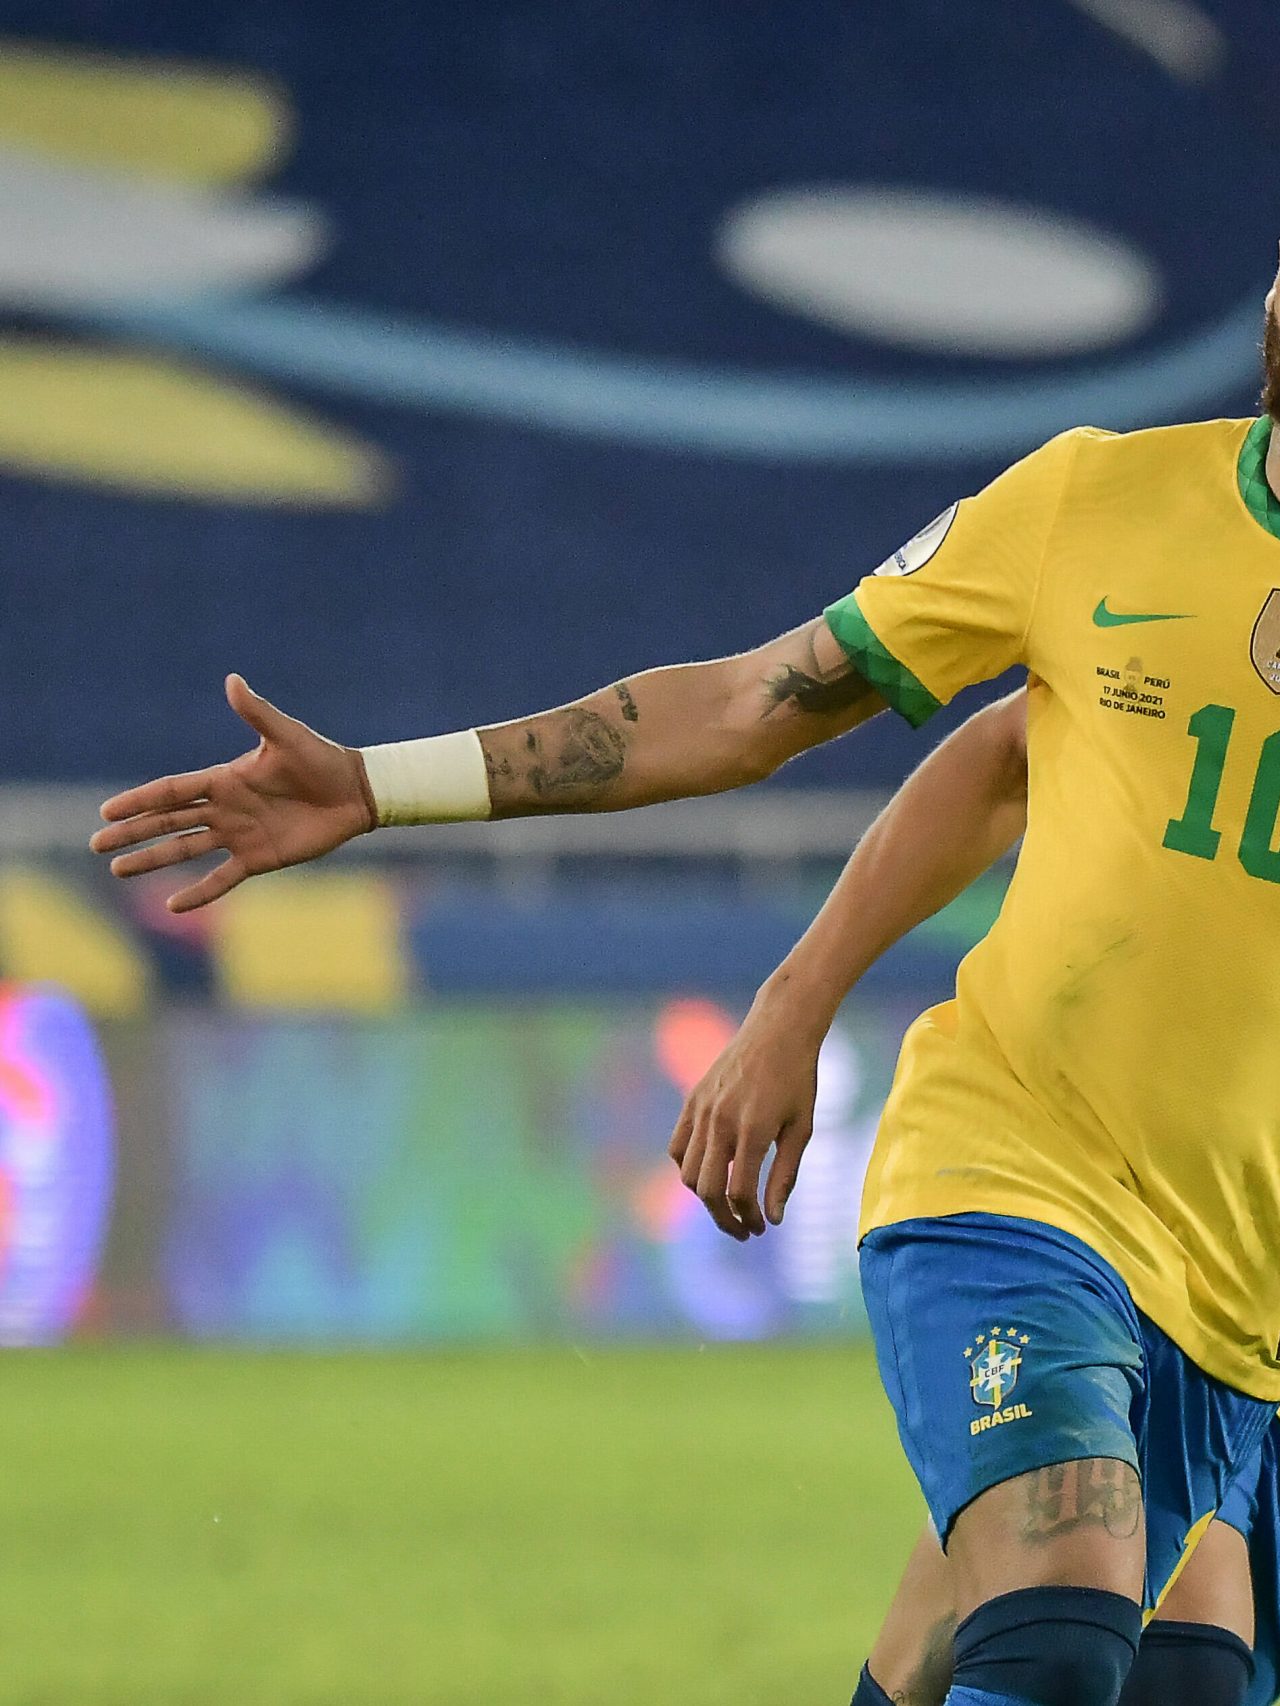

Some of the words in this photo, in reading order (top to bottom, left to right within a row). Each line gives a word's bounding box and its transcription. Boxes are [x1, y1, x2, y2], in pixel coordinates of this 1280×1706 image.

[1096, 666, 1120, 680] BRASIL
[1143, 676, 1171, 689] PERÚ
[1103, 685, 1111, 695] 17
[1111, 687, 1138, 701] JUNIO
[1139, 693, 1163, 706] 2021
[1099, 697, 1112, 708] RIO
[1113, 701, 1125, 711] DE
[1125, 704, 1166, 720] JANEIRO
[984, 1364, 1005, 1379] CBF
[970, 1403, 1033, 1436] BRASIL
